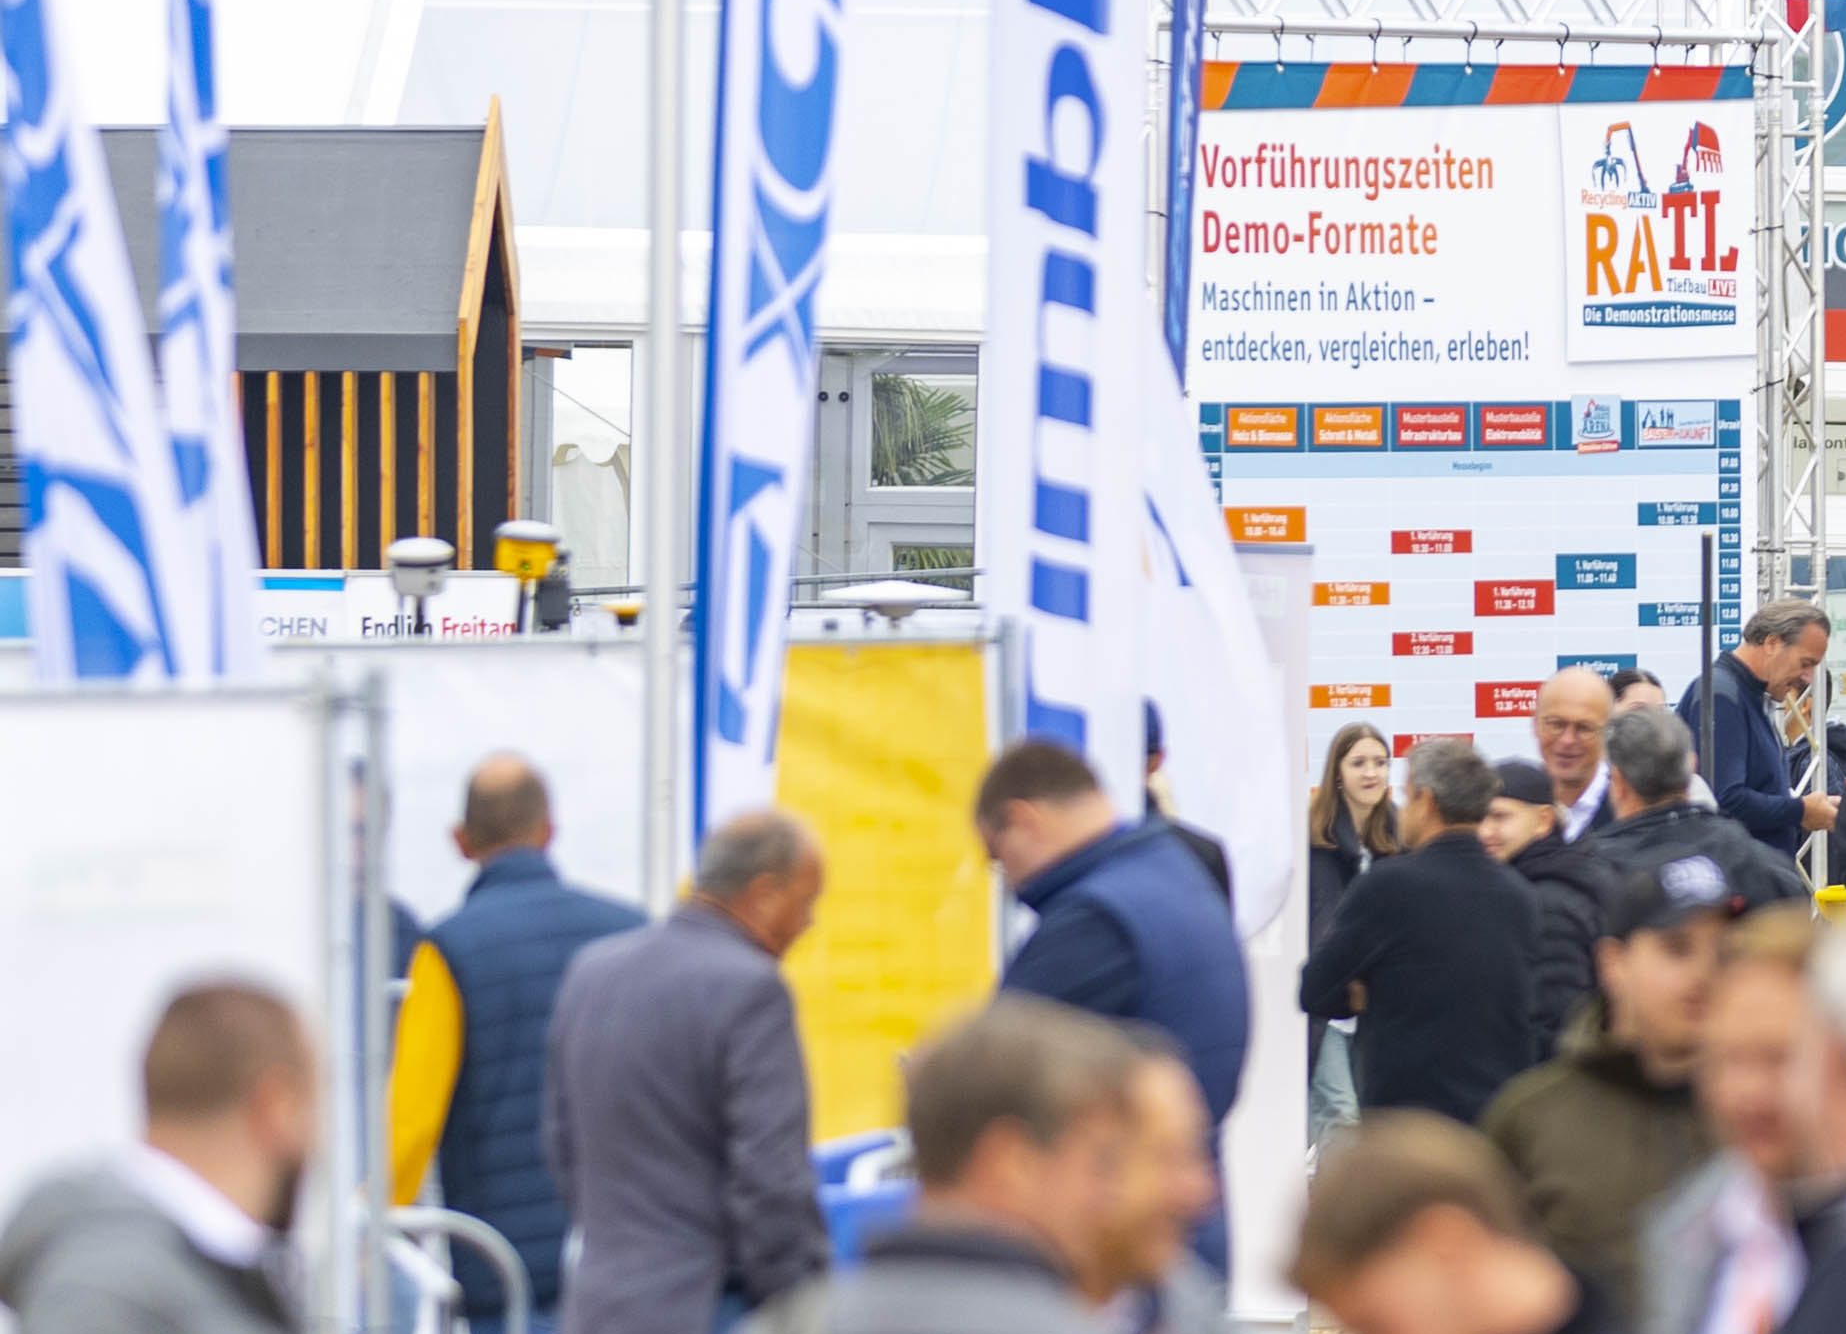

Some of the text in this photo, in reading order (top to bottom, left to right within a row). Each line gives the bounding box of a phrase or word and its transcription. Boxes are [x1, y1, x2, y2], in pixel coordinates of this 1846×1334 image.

[1200, 142, 1494, 201] Vorführungszeiten
[1202, 209, 1438, 256] Demo-Formate
[1202, 280, 1312, 312] Maschinen
[1319, 280, 1338, 312] in
[1345, 281, 1416, 312] Aktion
[1584, 304, 1735, 324] Die Demonstrationsmesse
[1202, 329, 1530, 370] entdecken, vergleichen, erleben!
[258, 615, 328, 636] CHEN
